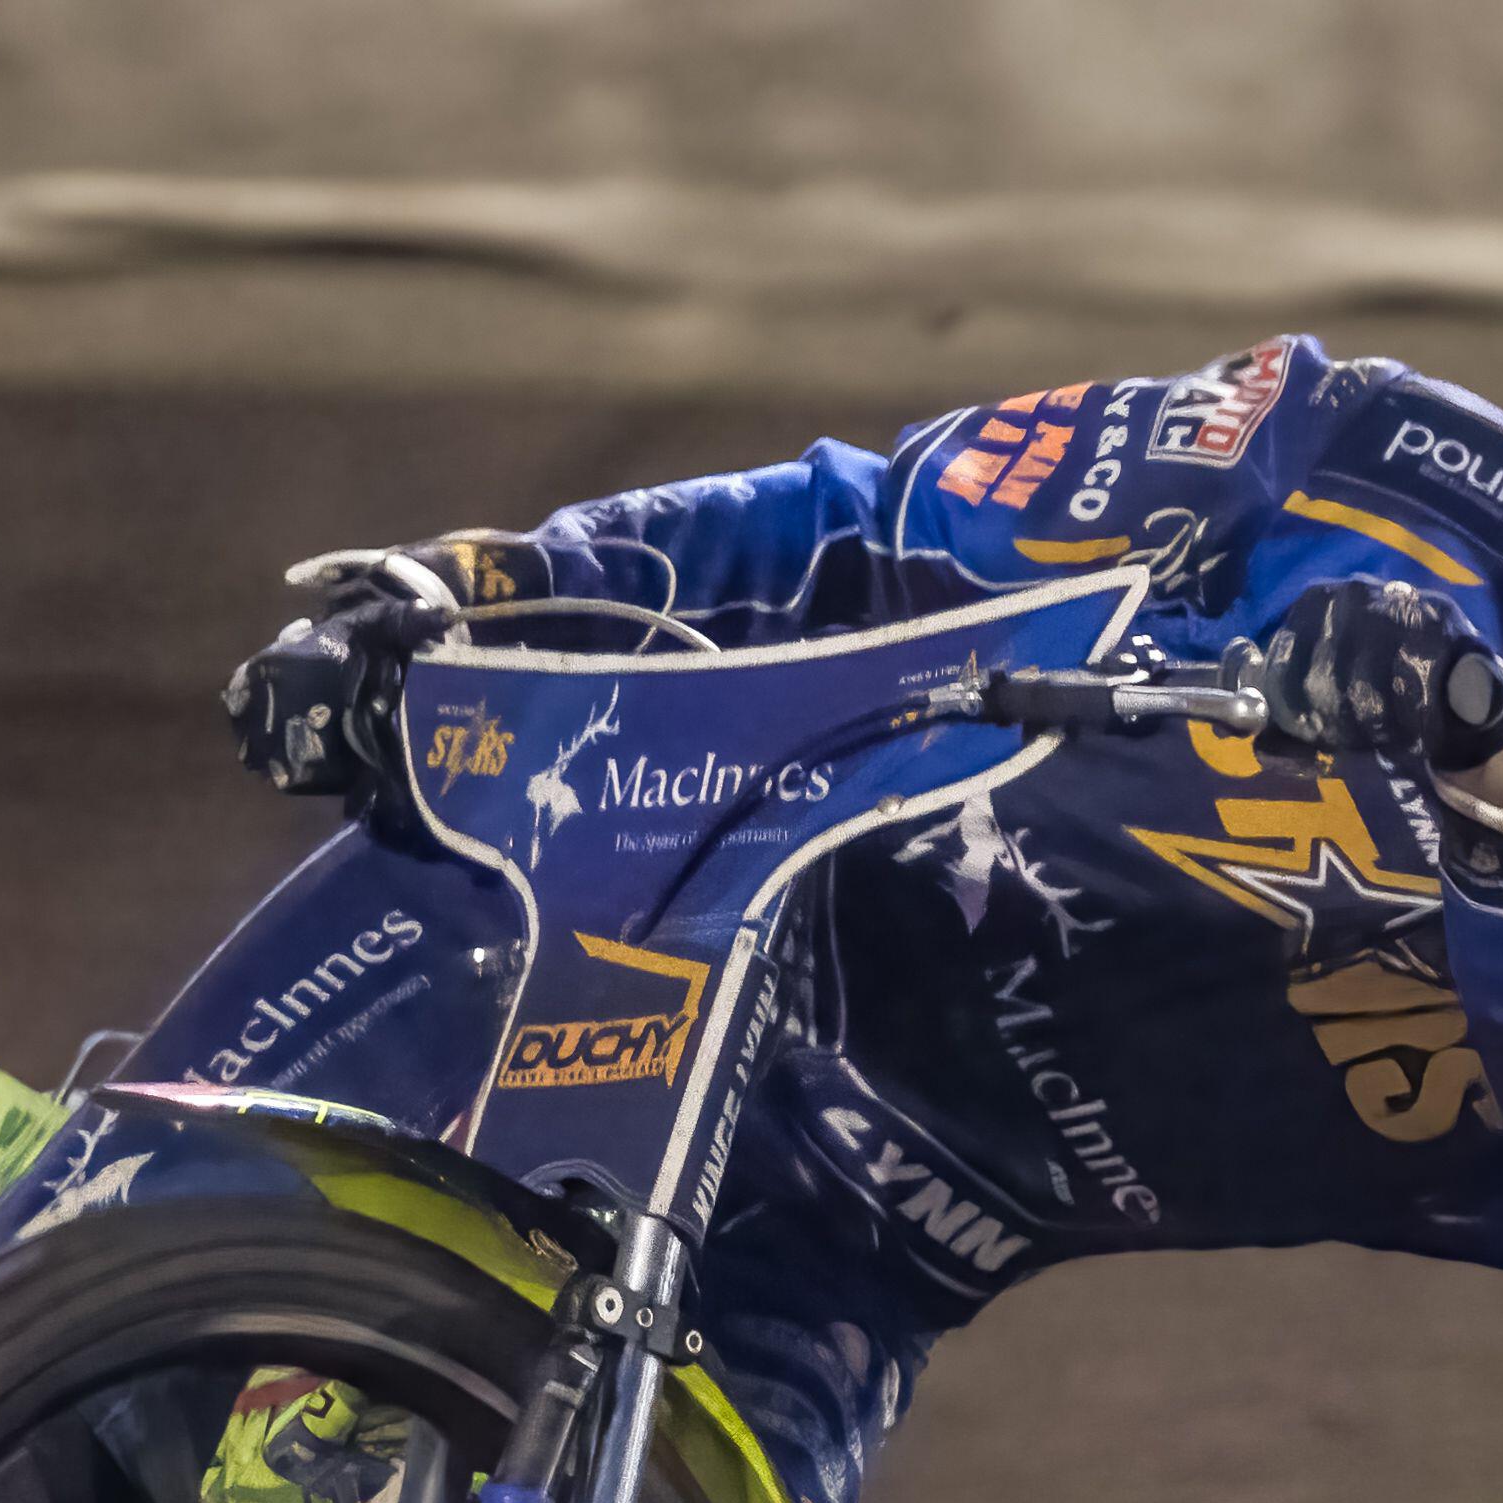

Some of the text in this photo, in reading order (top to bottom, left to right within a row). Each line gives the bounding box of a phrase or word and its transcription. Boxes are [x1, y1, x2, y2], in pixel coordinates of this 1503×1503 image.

[188, 907, 424, 1086] acInnes
[511, 1013, 686, 1071] DUCHY
[984, 954, 1162, 1226] McInne
